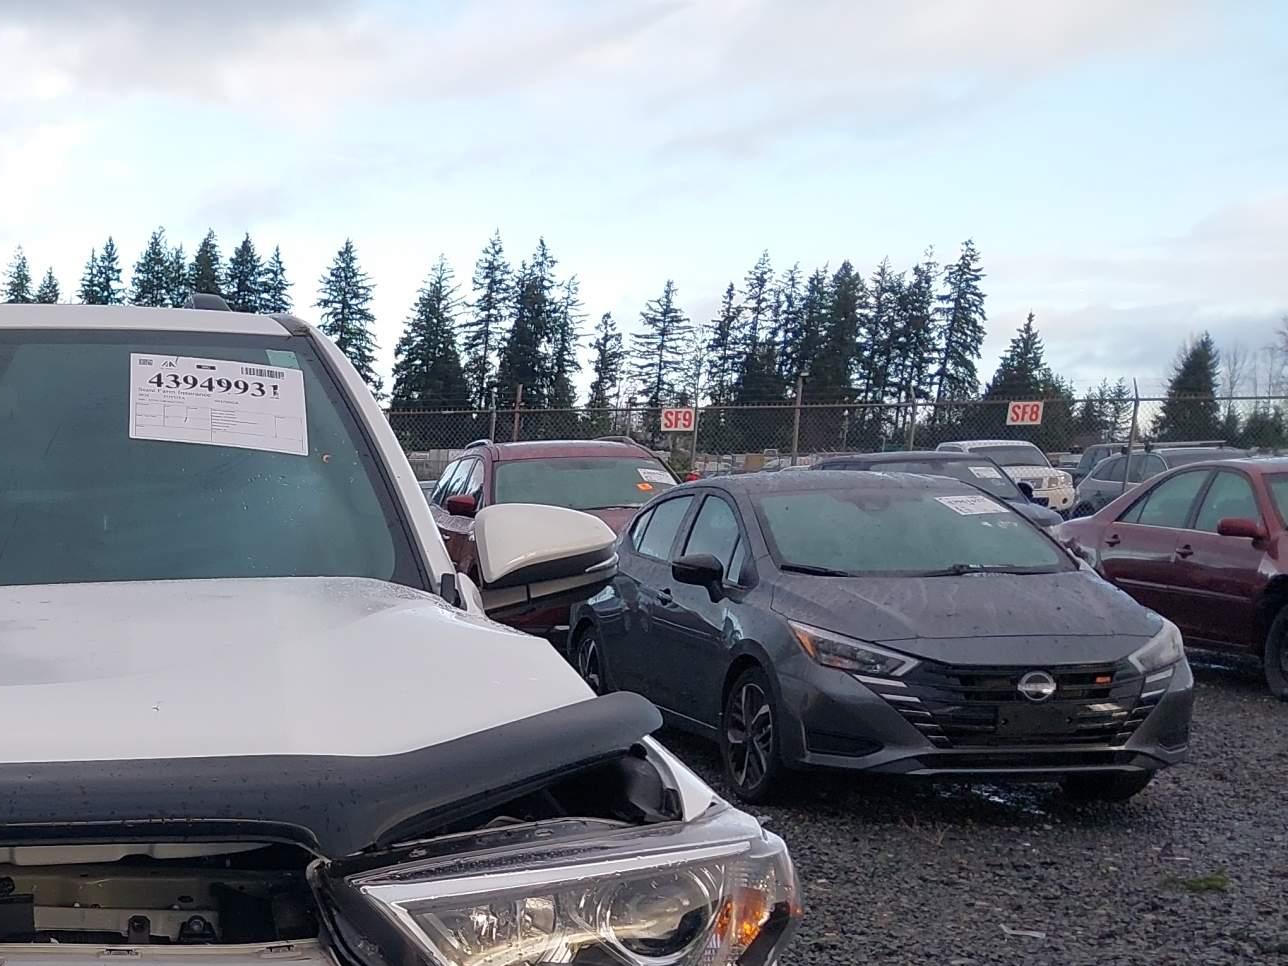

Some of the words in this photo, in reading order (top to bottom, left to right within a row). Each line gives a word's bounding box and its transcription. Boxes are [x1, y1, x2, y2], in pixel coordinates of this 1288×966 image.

[148, 372, 281, 400] 43949931
[664, 410, 693, 429] SF9
[1010, 404, 1040, 422] SF8
